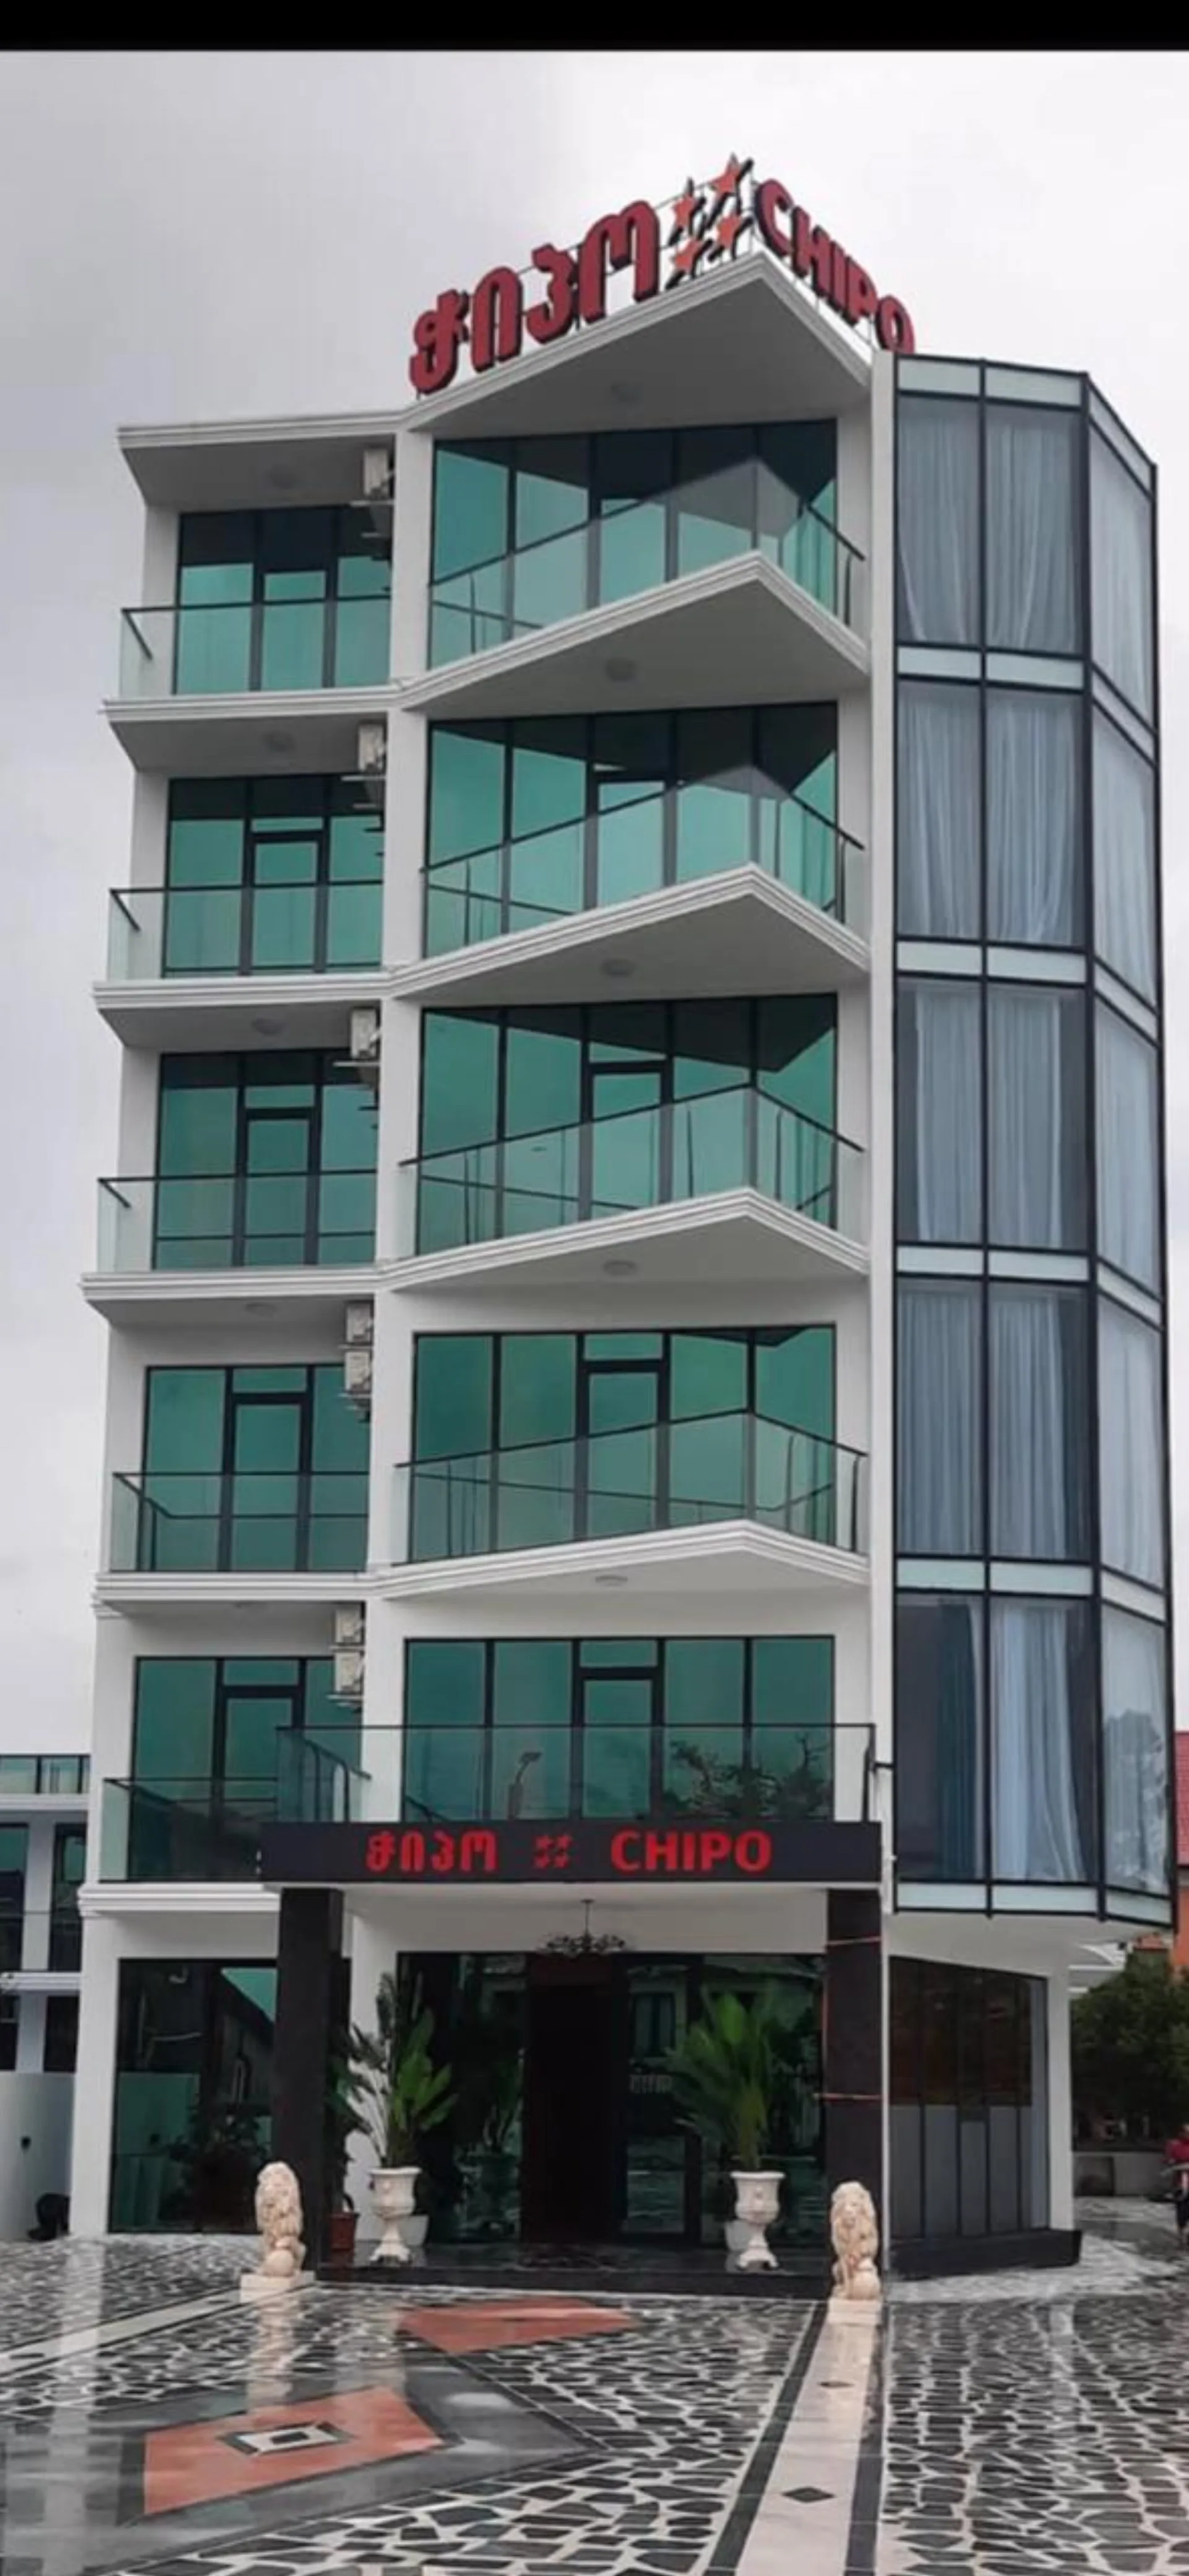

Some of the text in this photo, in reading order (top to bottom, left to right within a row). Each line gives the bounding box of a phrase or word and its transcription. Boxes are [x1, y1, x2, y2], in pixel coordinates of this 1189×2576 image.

[409, 200, 660, 395] ჭიპო
[754, 178, 916, 354] CHIPO
[365, 1829, 498, 1874] ჭიპო
[610, 1828, 773, 1872] CHIPO
